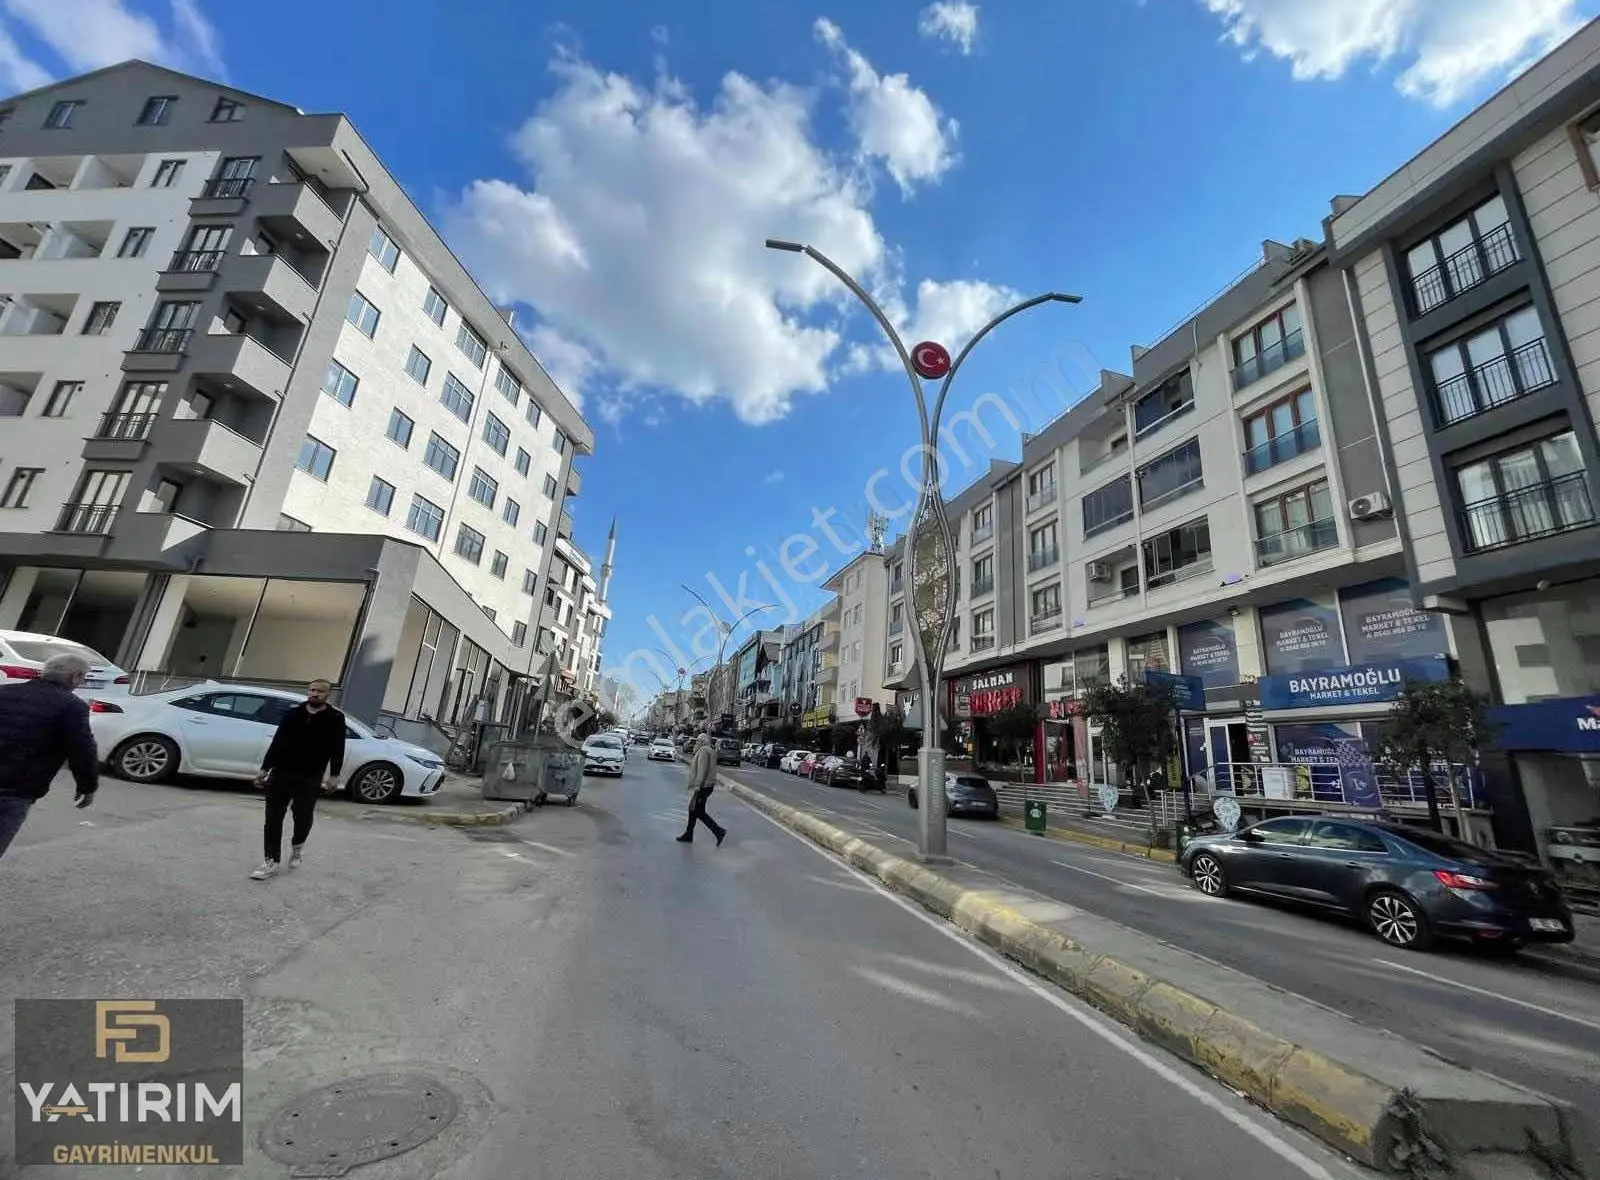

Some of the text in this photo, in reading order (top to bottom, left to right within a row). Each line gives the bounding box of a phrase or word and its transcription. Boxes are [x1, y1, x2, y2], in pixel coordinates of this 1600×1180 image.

[972, 672, 1013, 690] SALMAN
[1288, 668, 1401, 693] BAYRAMOĞLU
[1310, 686, 1381, 700] MARKET & TEKEL
[1576, 717, 1600, 731] M
